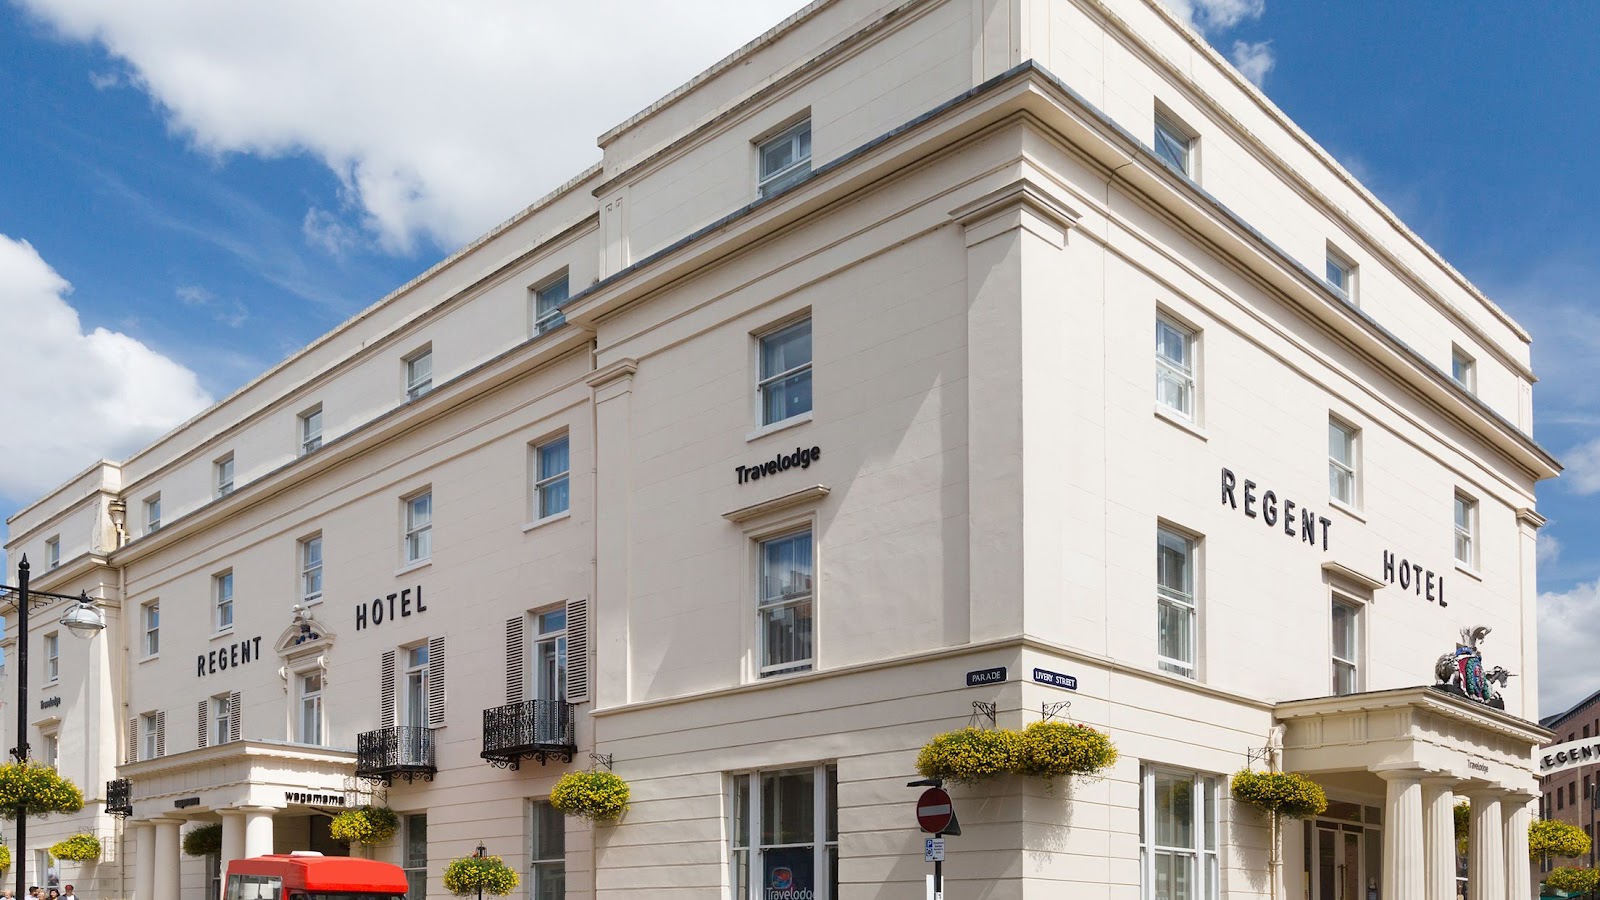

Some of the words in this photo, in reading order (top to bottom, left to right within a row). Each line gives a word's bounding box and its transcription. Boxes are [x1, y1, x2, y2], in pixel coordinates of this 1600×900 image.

[735, 446, 821, 484] Travelodge
[1221, 467, 1332, 552] REGENT
[1384, 549, 1447, 608] HOTEL
[197, 635, 262, 678] REGENT
[356, 585, 427, 631] HOTEL
[972, 671, 1001, 682] PARADE
[1035, 671, 1053, 683] LIVERY
[1056, 676, 1075, 688] STREET
[1540, 743, 1600, 769] EGENT
[285, 791, 345, 807] wagamama
[766, 887, 814, 900] Travelodg
